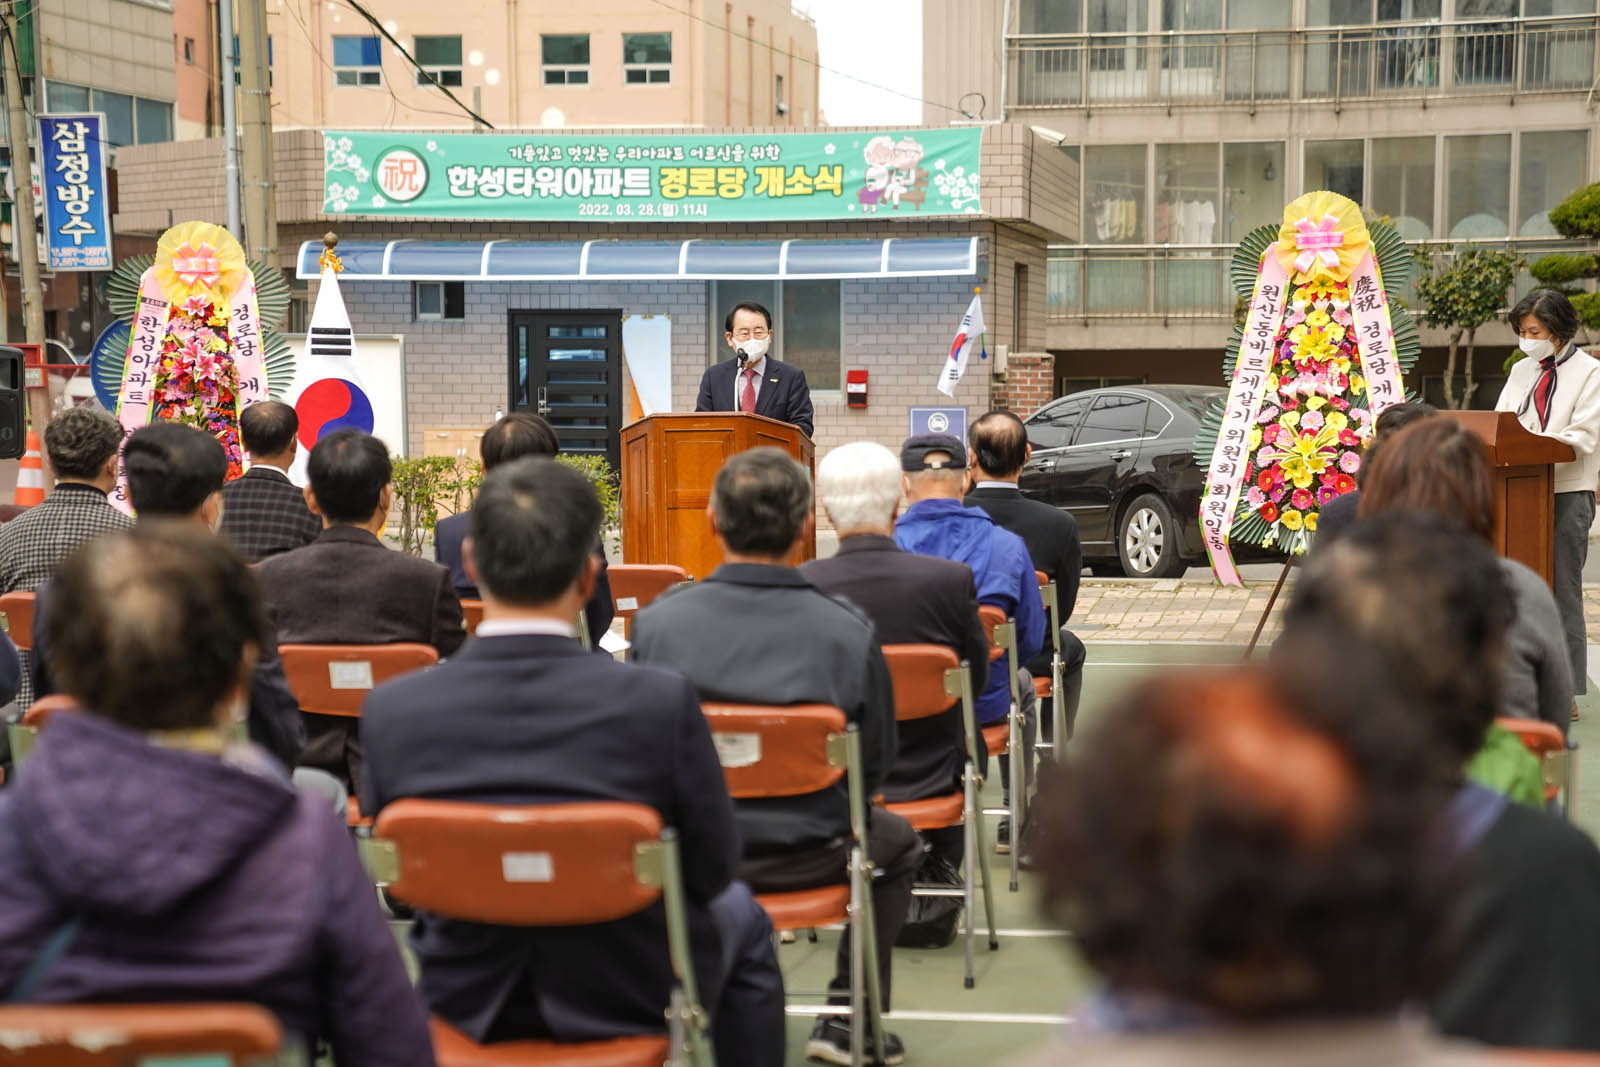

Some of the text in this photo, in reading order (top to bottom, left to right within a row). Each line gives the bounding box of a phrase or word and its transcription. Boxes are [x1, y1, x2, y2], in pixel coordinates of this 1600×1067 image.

[508, 144, 562, 162] 기품있고
[615, 145, 685, 162] 우리아파트
[689, 143, 745, 162] 어르신을
[749, 143, 782, 161] 위한
[52, 121, 96, 246] 삼정방수
[383, 157, 419, 193] 祝
[447, 165, 843, 198] 한성타워아파트 경로당 개소식
[578, 203, 613, 216] 2022.
[616, 203, 635, 216] 03.
[682, 203, 708, 216] 11시
[1354, 275, 1381, 312] 慶祝
[232, 303, 257, 357] 경로당
[1362, 320, 1390, 375] 경로당
[123, 315, 161, 405] 한성아파트
[1216, 428, 1245, 478] 위원회
